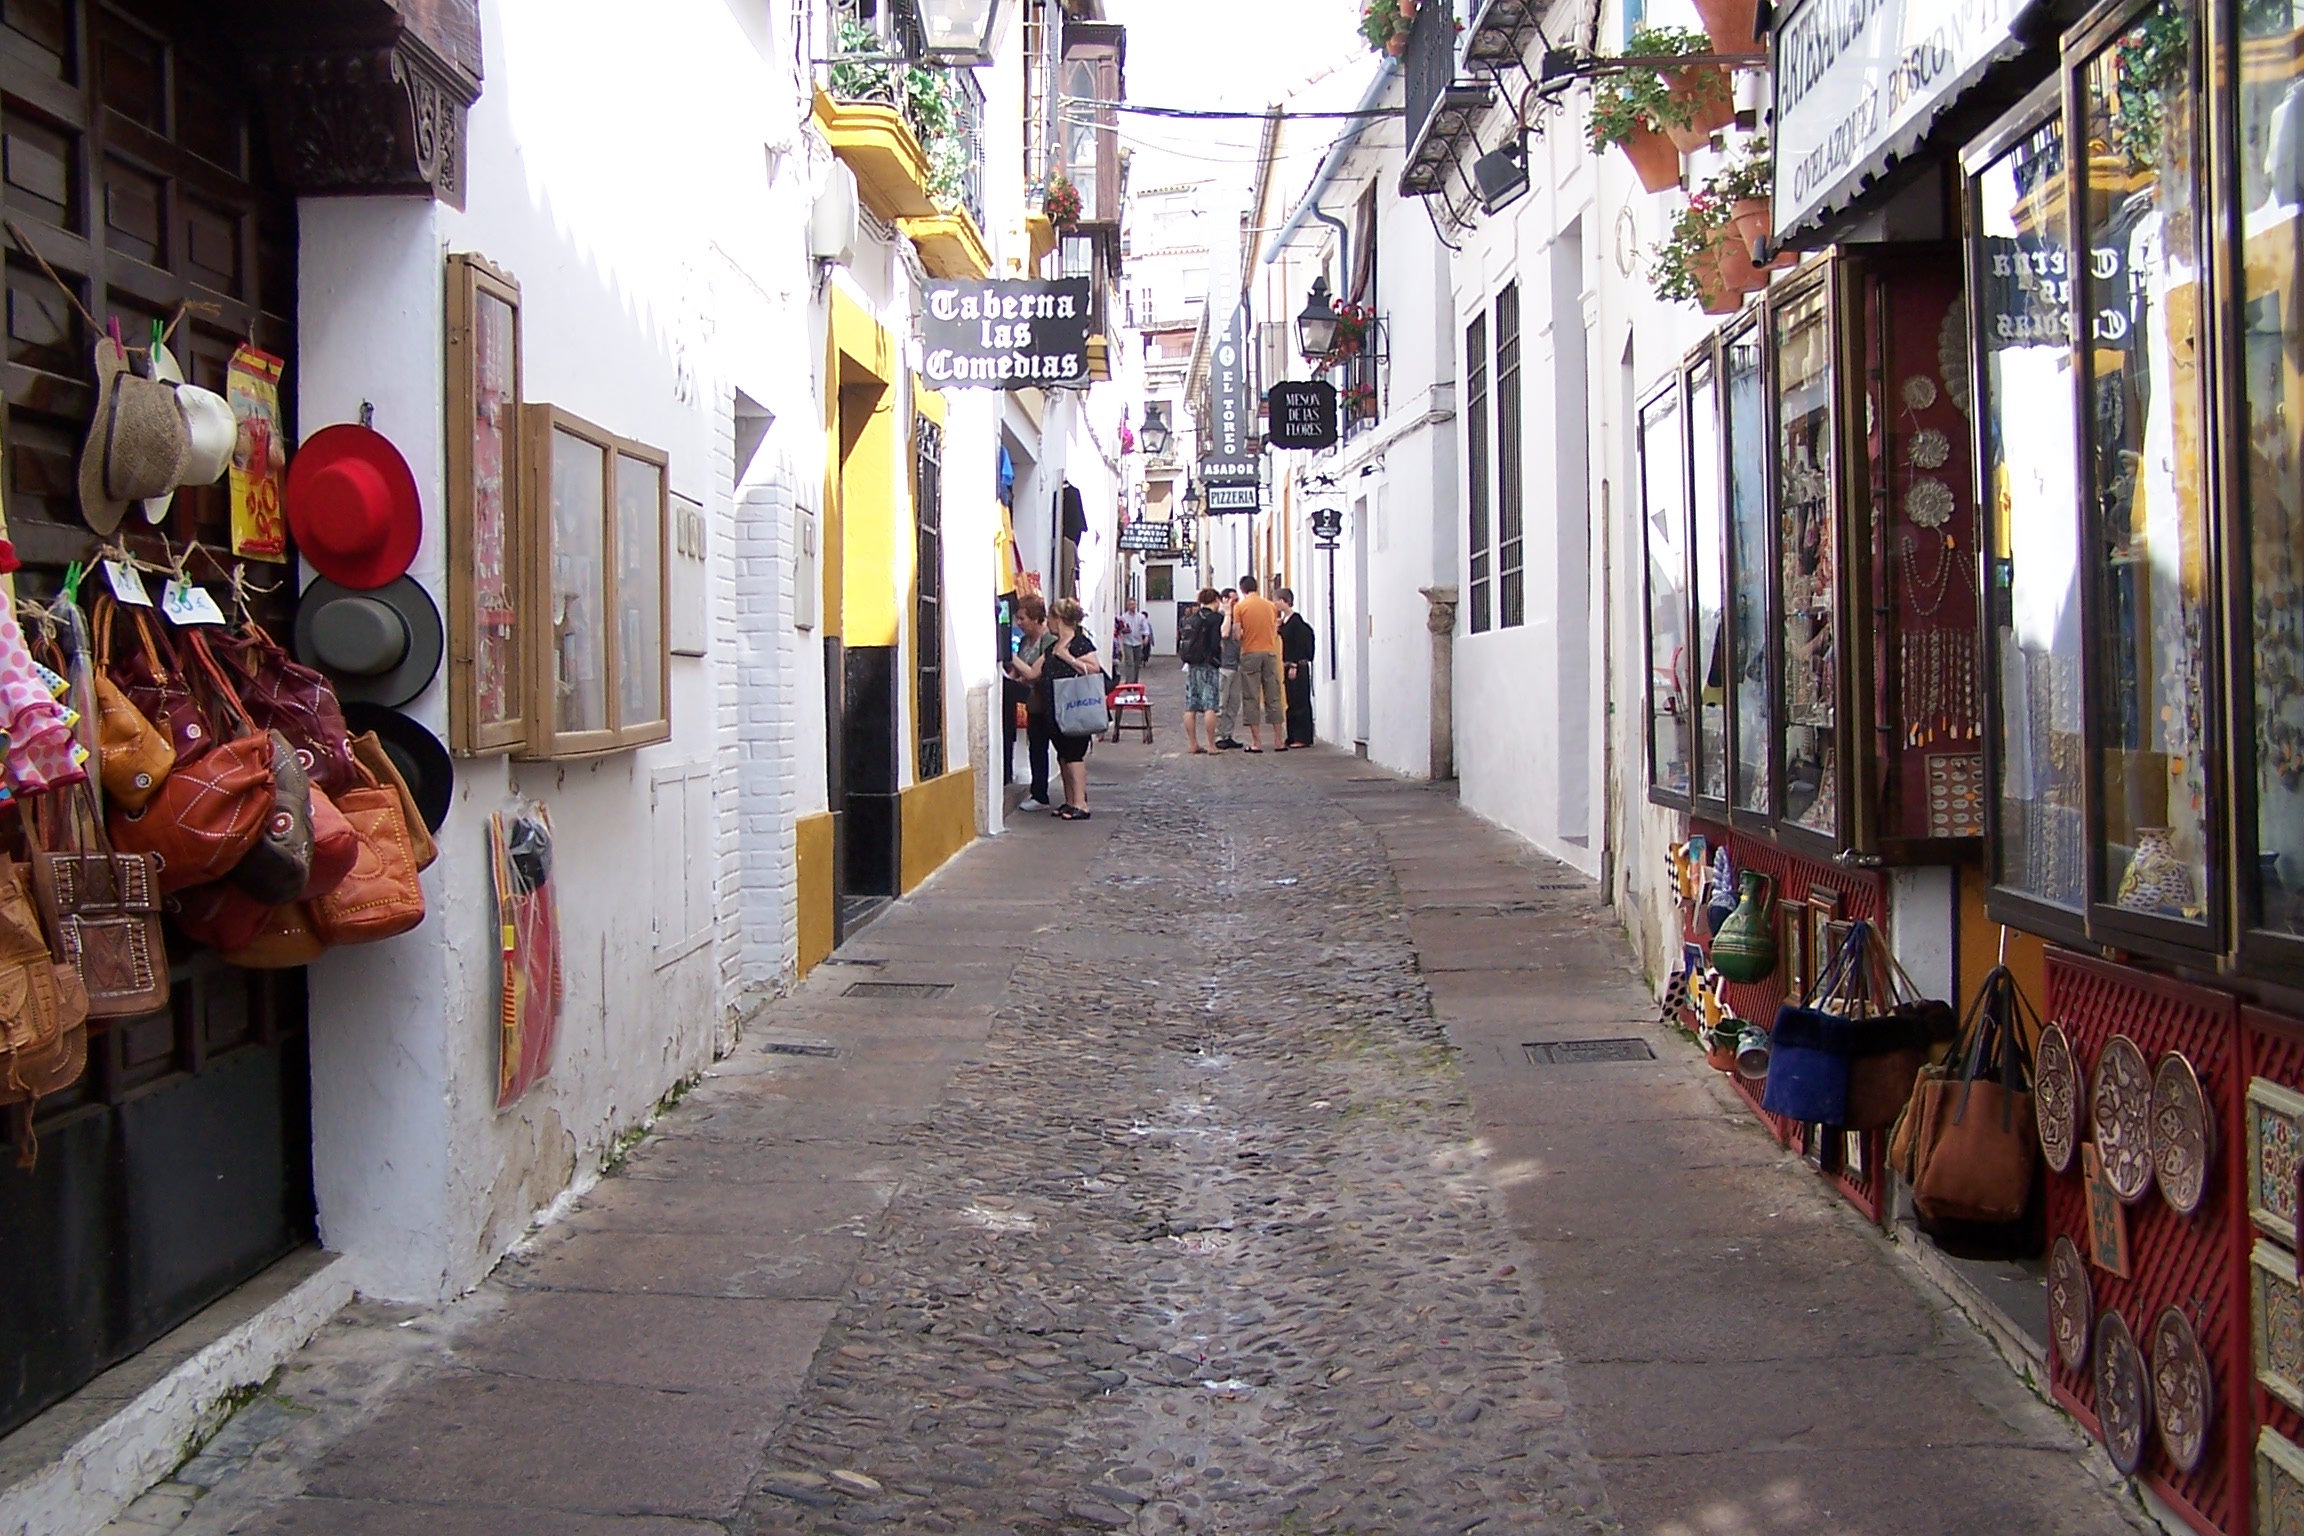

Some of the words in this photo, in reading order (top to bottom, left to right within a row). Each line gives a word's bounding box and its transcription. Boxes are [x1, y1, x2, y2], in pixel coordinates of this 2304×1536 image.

[1888, 25, 1945, 118] BOSCO
[930, 288, 1076, 321] Taberna
[980, 319, 1031, 349] las
[926, 348, 1078, 380] Comedias
[1222, 371, 1233, 393] EL
[1286, 393, 1320, 407] MESON
[1289, 408, 1300, 421] DE
[1303, 408, 1320, 421] LAS
[1222, 399, 1236, 455] TOREO
[1286, 423, 1322, 436] FLORES
[1204, 463, 1254, 475] ASADOR
[1211, 490, 1254, 505] PIZZERIA
